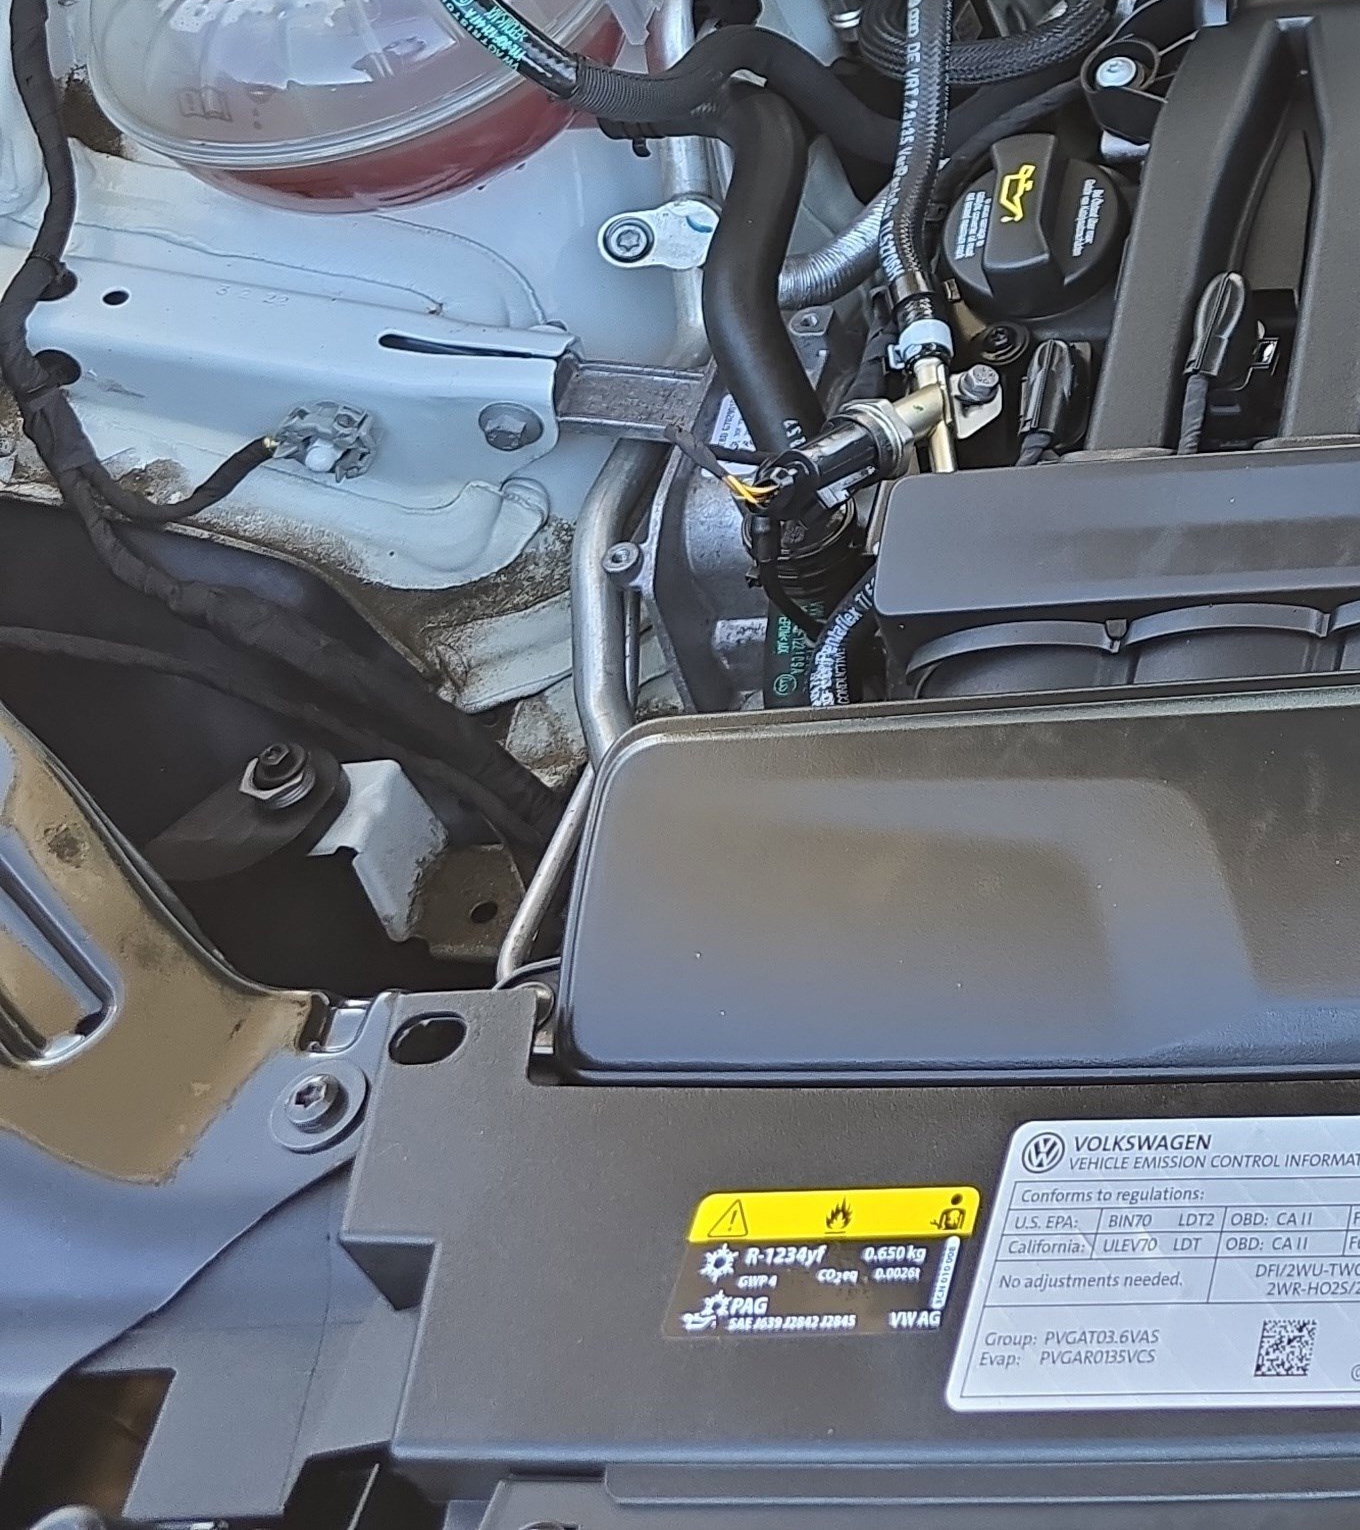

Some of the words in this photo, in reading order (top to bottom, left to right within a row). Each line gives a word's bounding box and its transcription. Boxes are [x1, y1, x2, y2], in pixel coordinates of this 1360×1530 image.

[1074, 1135, 1211, 1151] VOLKSWAGEN
[1070, 1156, 1129, 1170] VEHICLE
[1134, 1155, 1206, 1169] EMISSION
[1211, 1154, 1280, 1168] CONTROL
[1022, 1188, 1092, 1203] Conforms
[1098, 1189, 1112, 1201] to
[1116, 1187, 1205, 1205] regulations:
[1015, 1216, 1041, 1229] U.S.
[1046, 1215, 1078, 1229] EPA:
[1109, 1214, 1152, 1227] BIN70
[1178, 1213, 1215, 1226] LDT2
[1230, 1213, 1268, 1226] OBD:
[1008, 1238, 1085, 1254] California:
[1103, 1238, 1157, 1252] ULEV70
[1173, 1237, 1202, 1251] LDT
[1225, 1237, 1264, 1250] OBD:
[745, 1244, 827, 1268] R-1234yf
[999, 1275, 1021, 1288] No
[1024, 1273, 1119, 1292] adjustments
[1123, 1271, 1183, 1286] needed.
[730, 1296, 769, 1314] PAG
[889, 1312, 916, 1328] VW
[918, 1311, 940, 1326] AG
[985, 1331, 1037, 1349] Group:
[1044, 1329, 1160, 1345] PVGAT03.6VAS
[979, 1351, 1021, 1369] Evap:
[1039, 1349, 1156, 1365] PVGAR0135VCS
